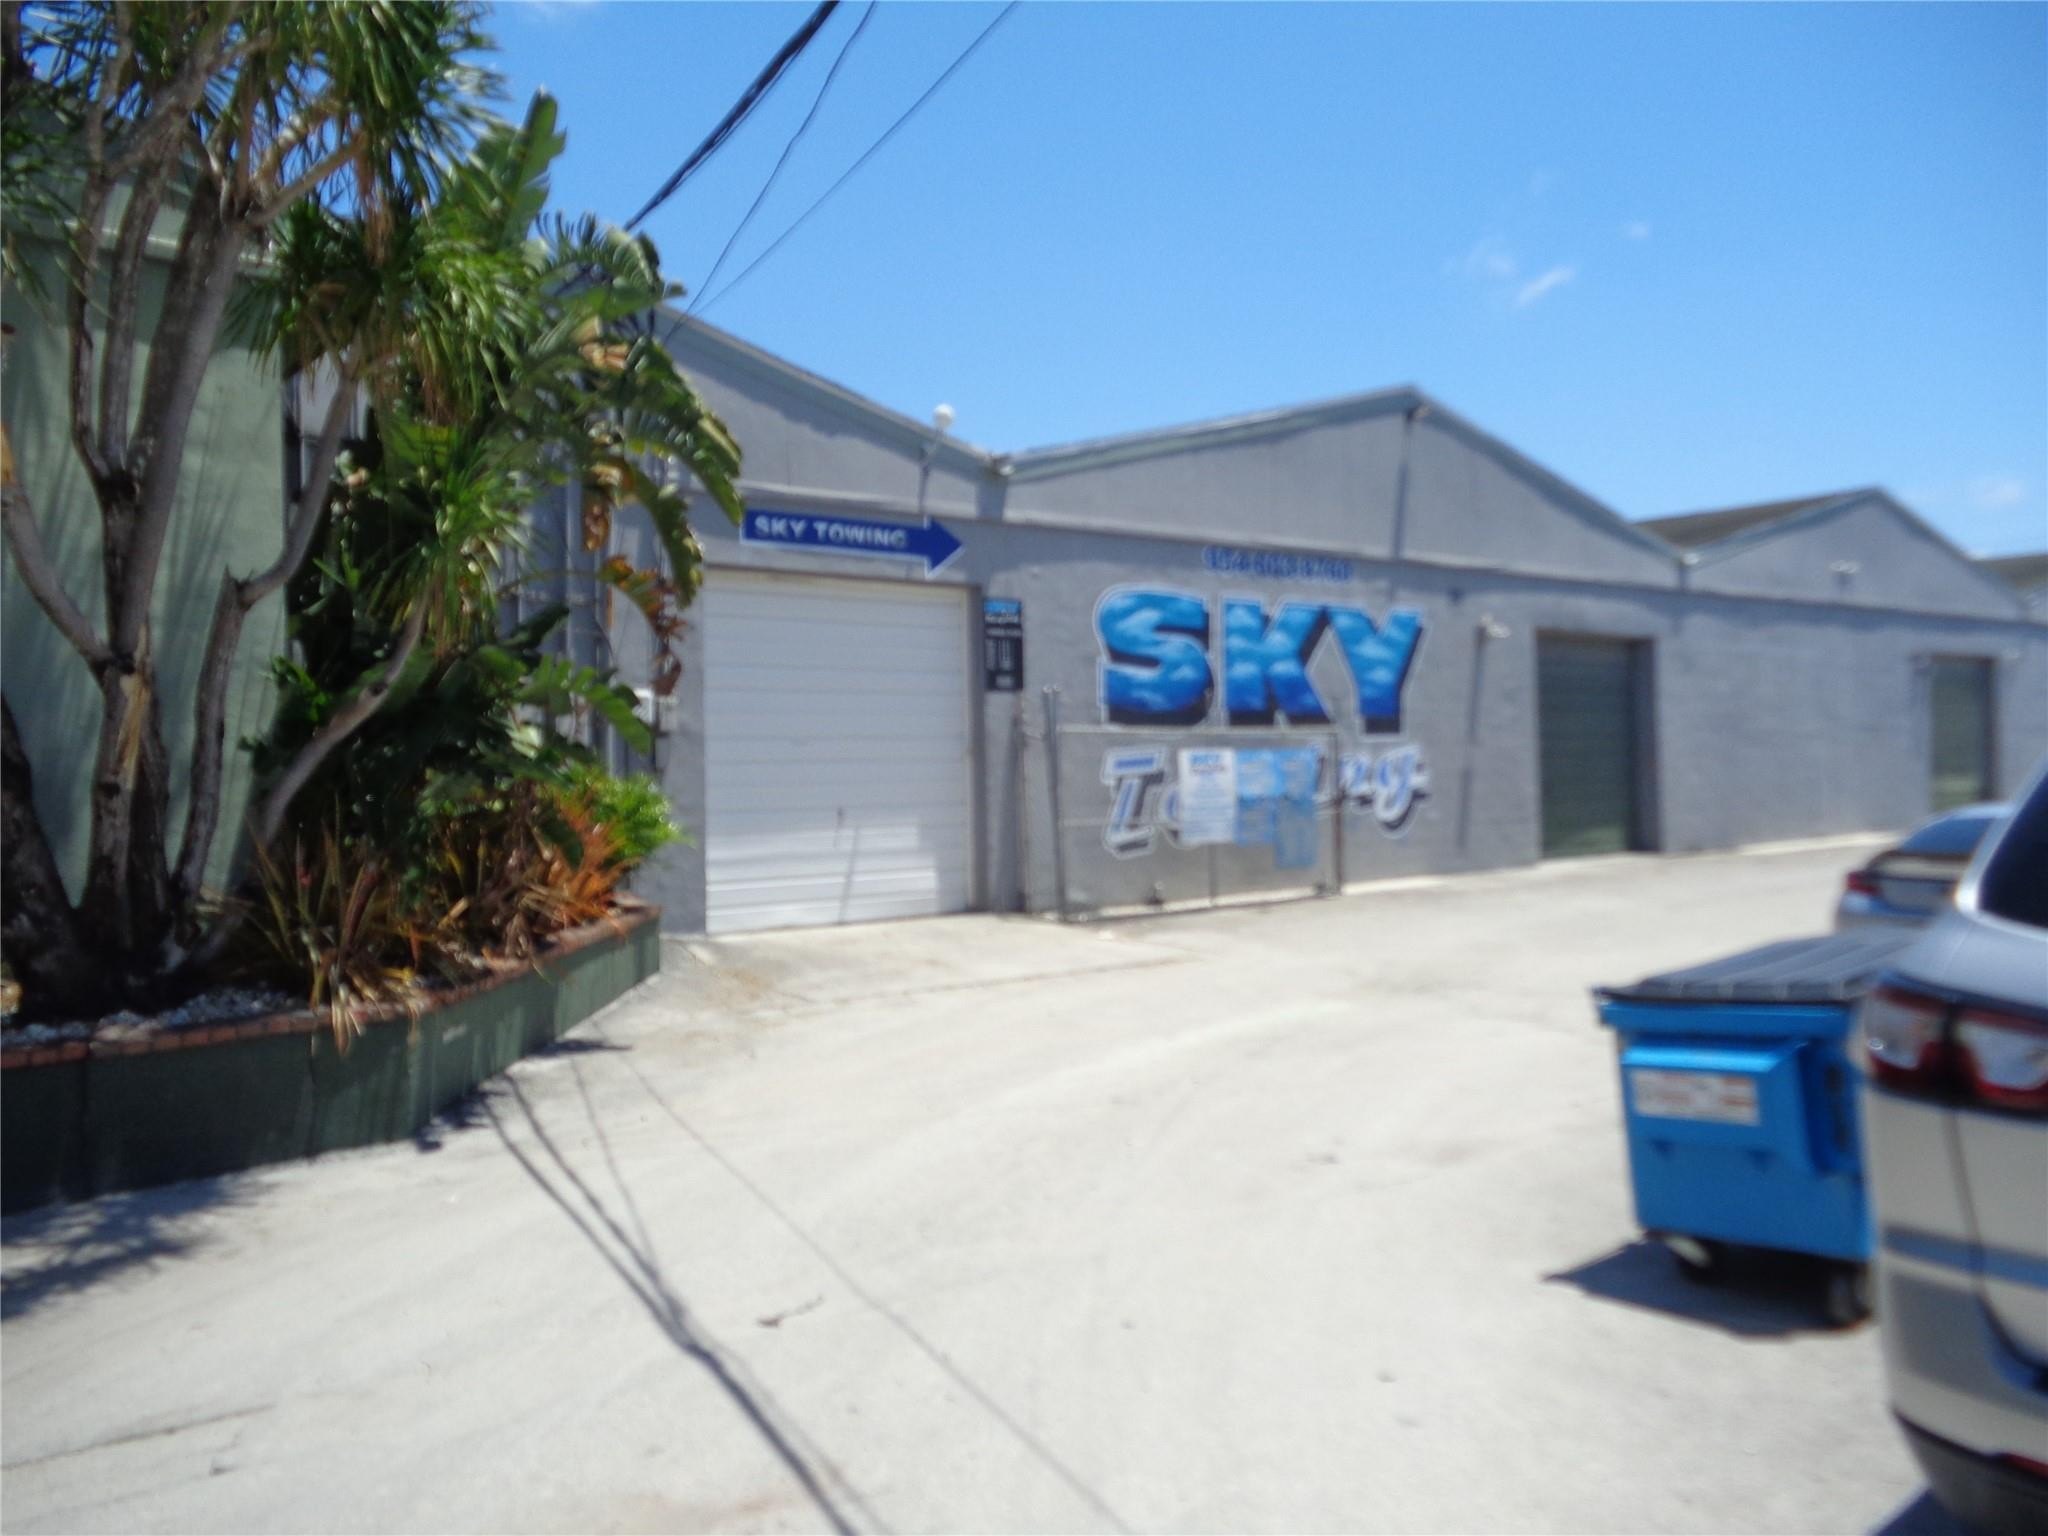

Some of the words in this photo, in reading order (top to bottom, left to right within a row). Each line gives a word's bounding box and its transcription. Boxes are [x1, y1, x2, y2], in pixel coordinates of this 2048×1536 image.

[754, 514, 806, 538] SKY
[813, 520, 907, 549] TOWING
[1097, 588, 1423, 734] SKY
